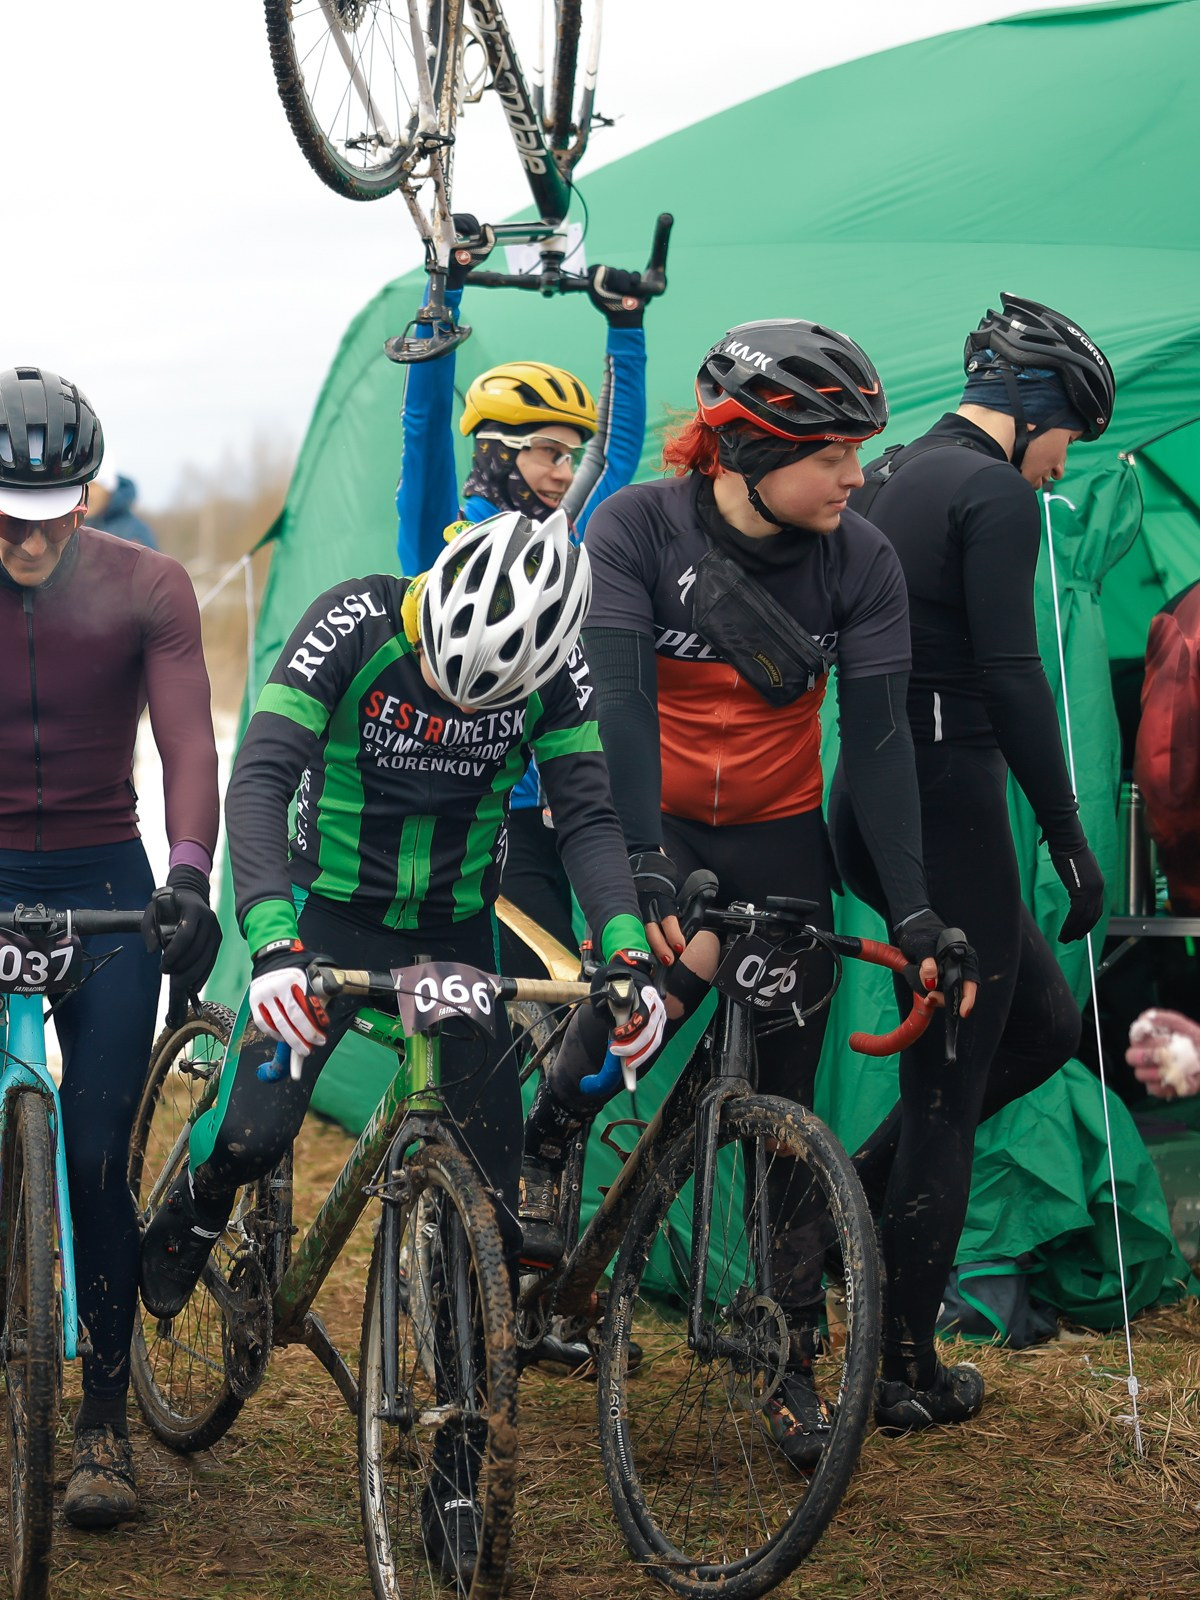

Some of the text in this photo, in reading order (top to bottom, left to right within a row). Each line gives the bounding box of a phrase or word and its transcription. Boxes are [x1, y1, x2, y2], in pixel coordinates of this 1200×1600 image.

[724, 340, 774, 372] KASK
[1079, 336, 1104, 366] GIRO
[365, 690, 527, 747] SESTRORETSK
[376, 755, 486, 777] KORENKOV
[414, 974, 492, 1016] 066
[735, 954, 797, 998] 026
[608, 1379, 621, 1420] 460
